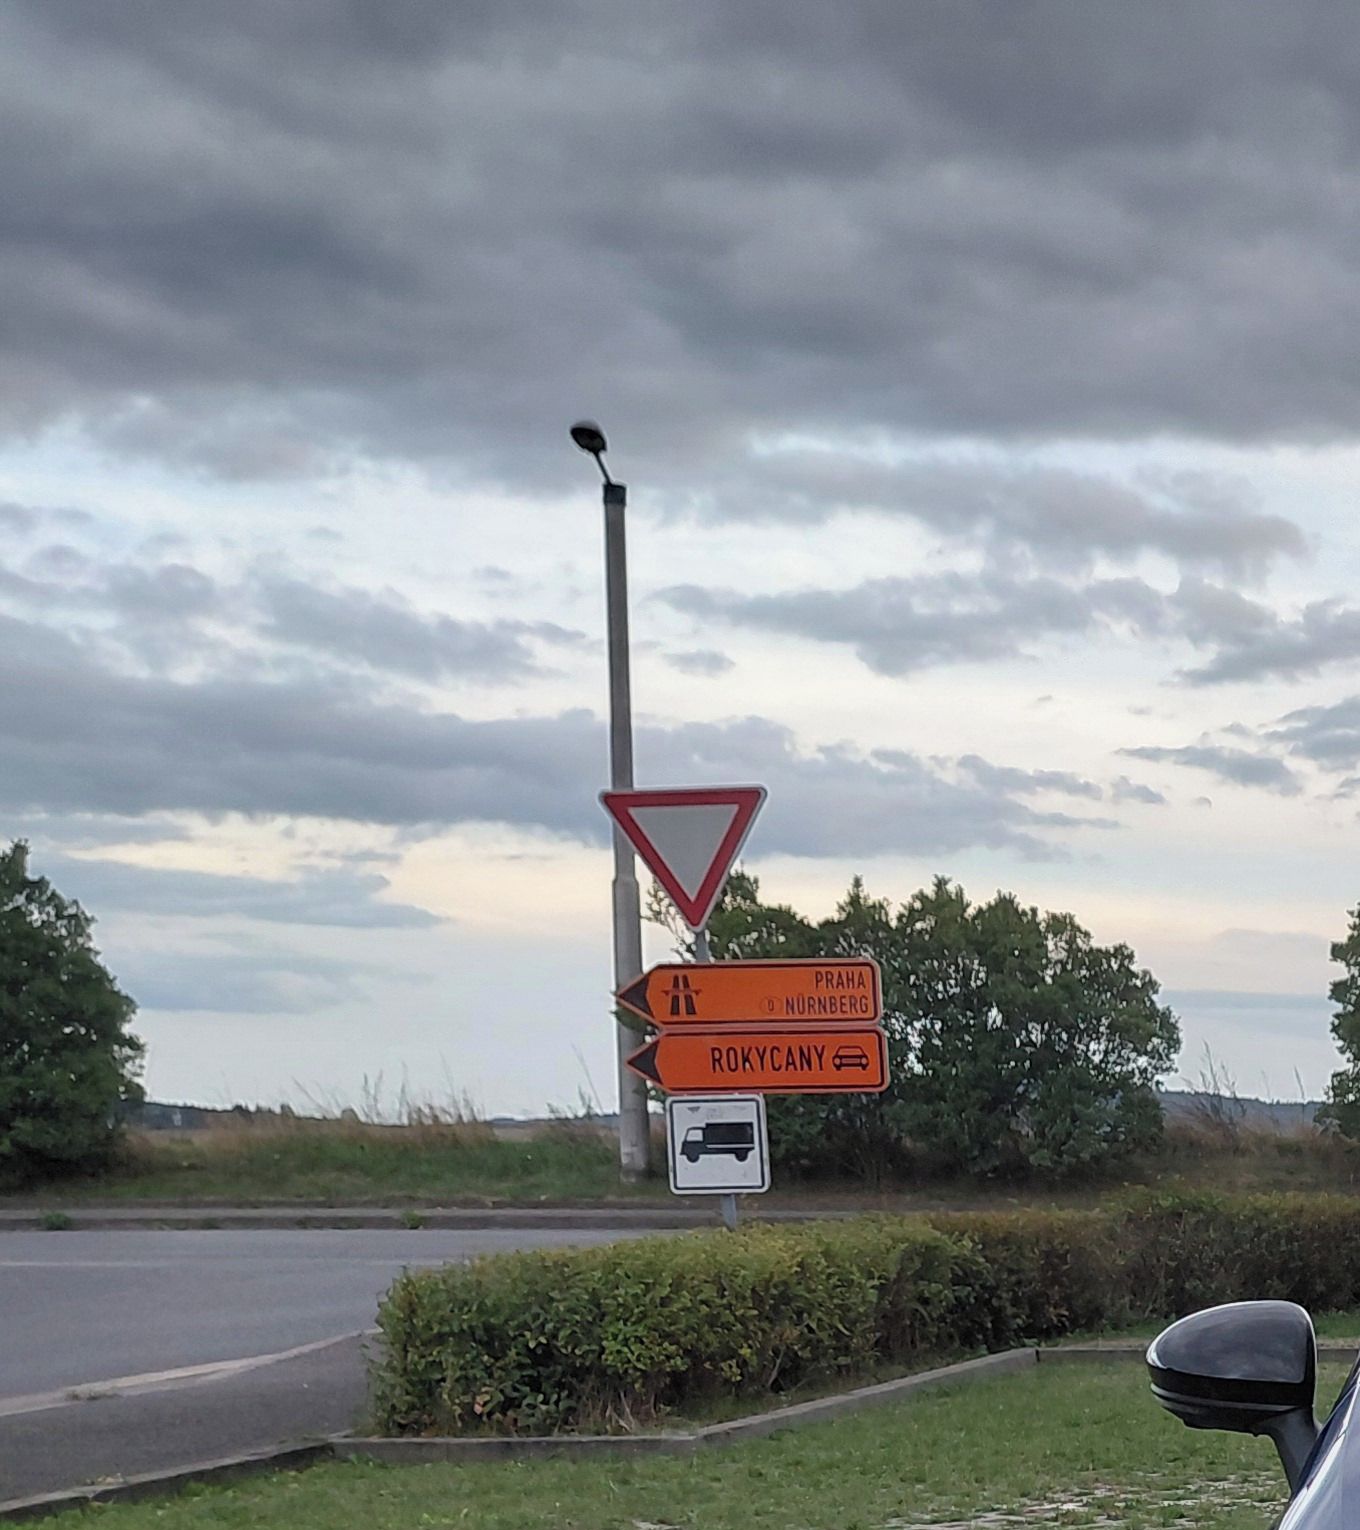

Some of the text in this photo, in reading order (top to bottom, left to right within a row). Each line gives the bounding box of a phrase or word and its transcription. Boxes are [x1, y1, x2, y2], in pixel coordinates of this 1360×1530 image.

[815, 970, 866, 989] PRAHA
[785, 993, 869, 1015] NÜRNBERG
[711, 1045, 826, 1073] ROKYCANY
